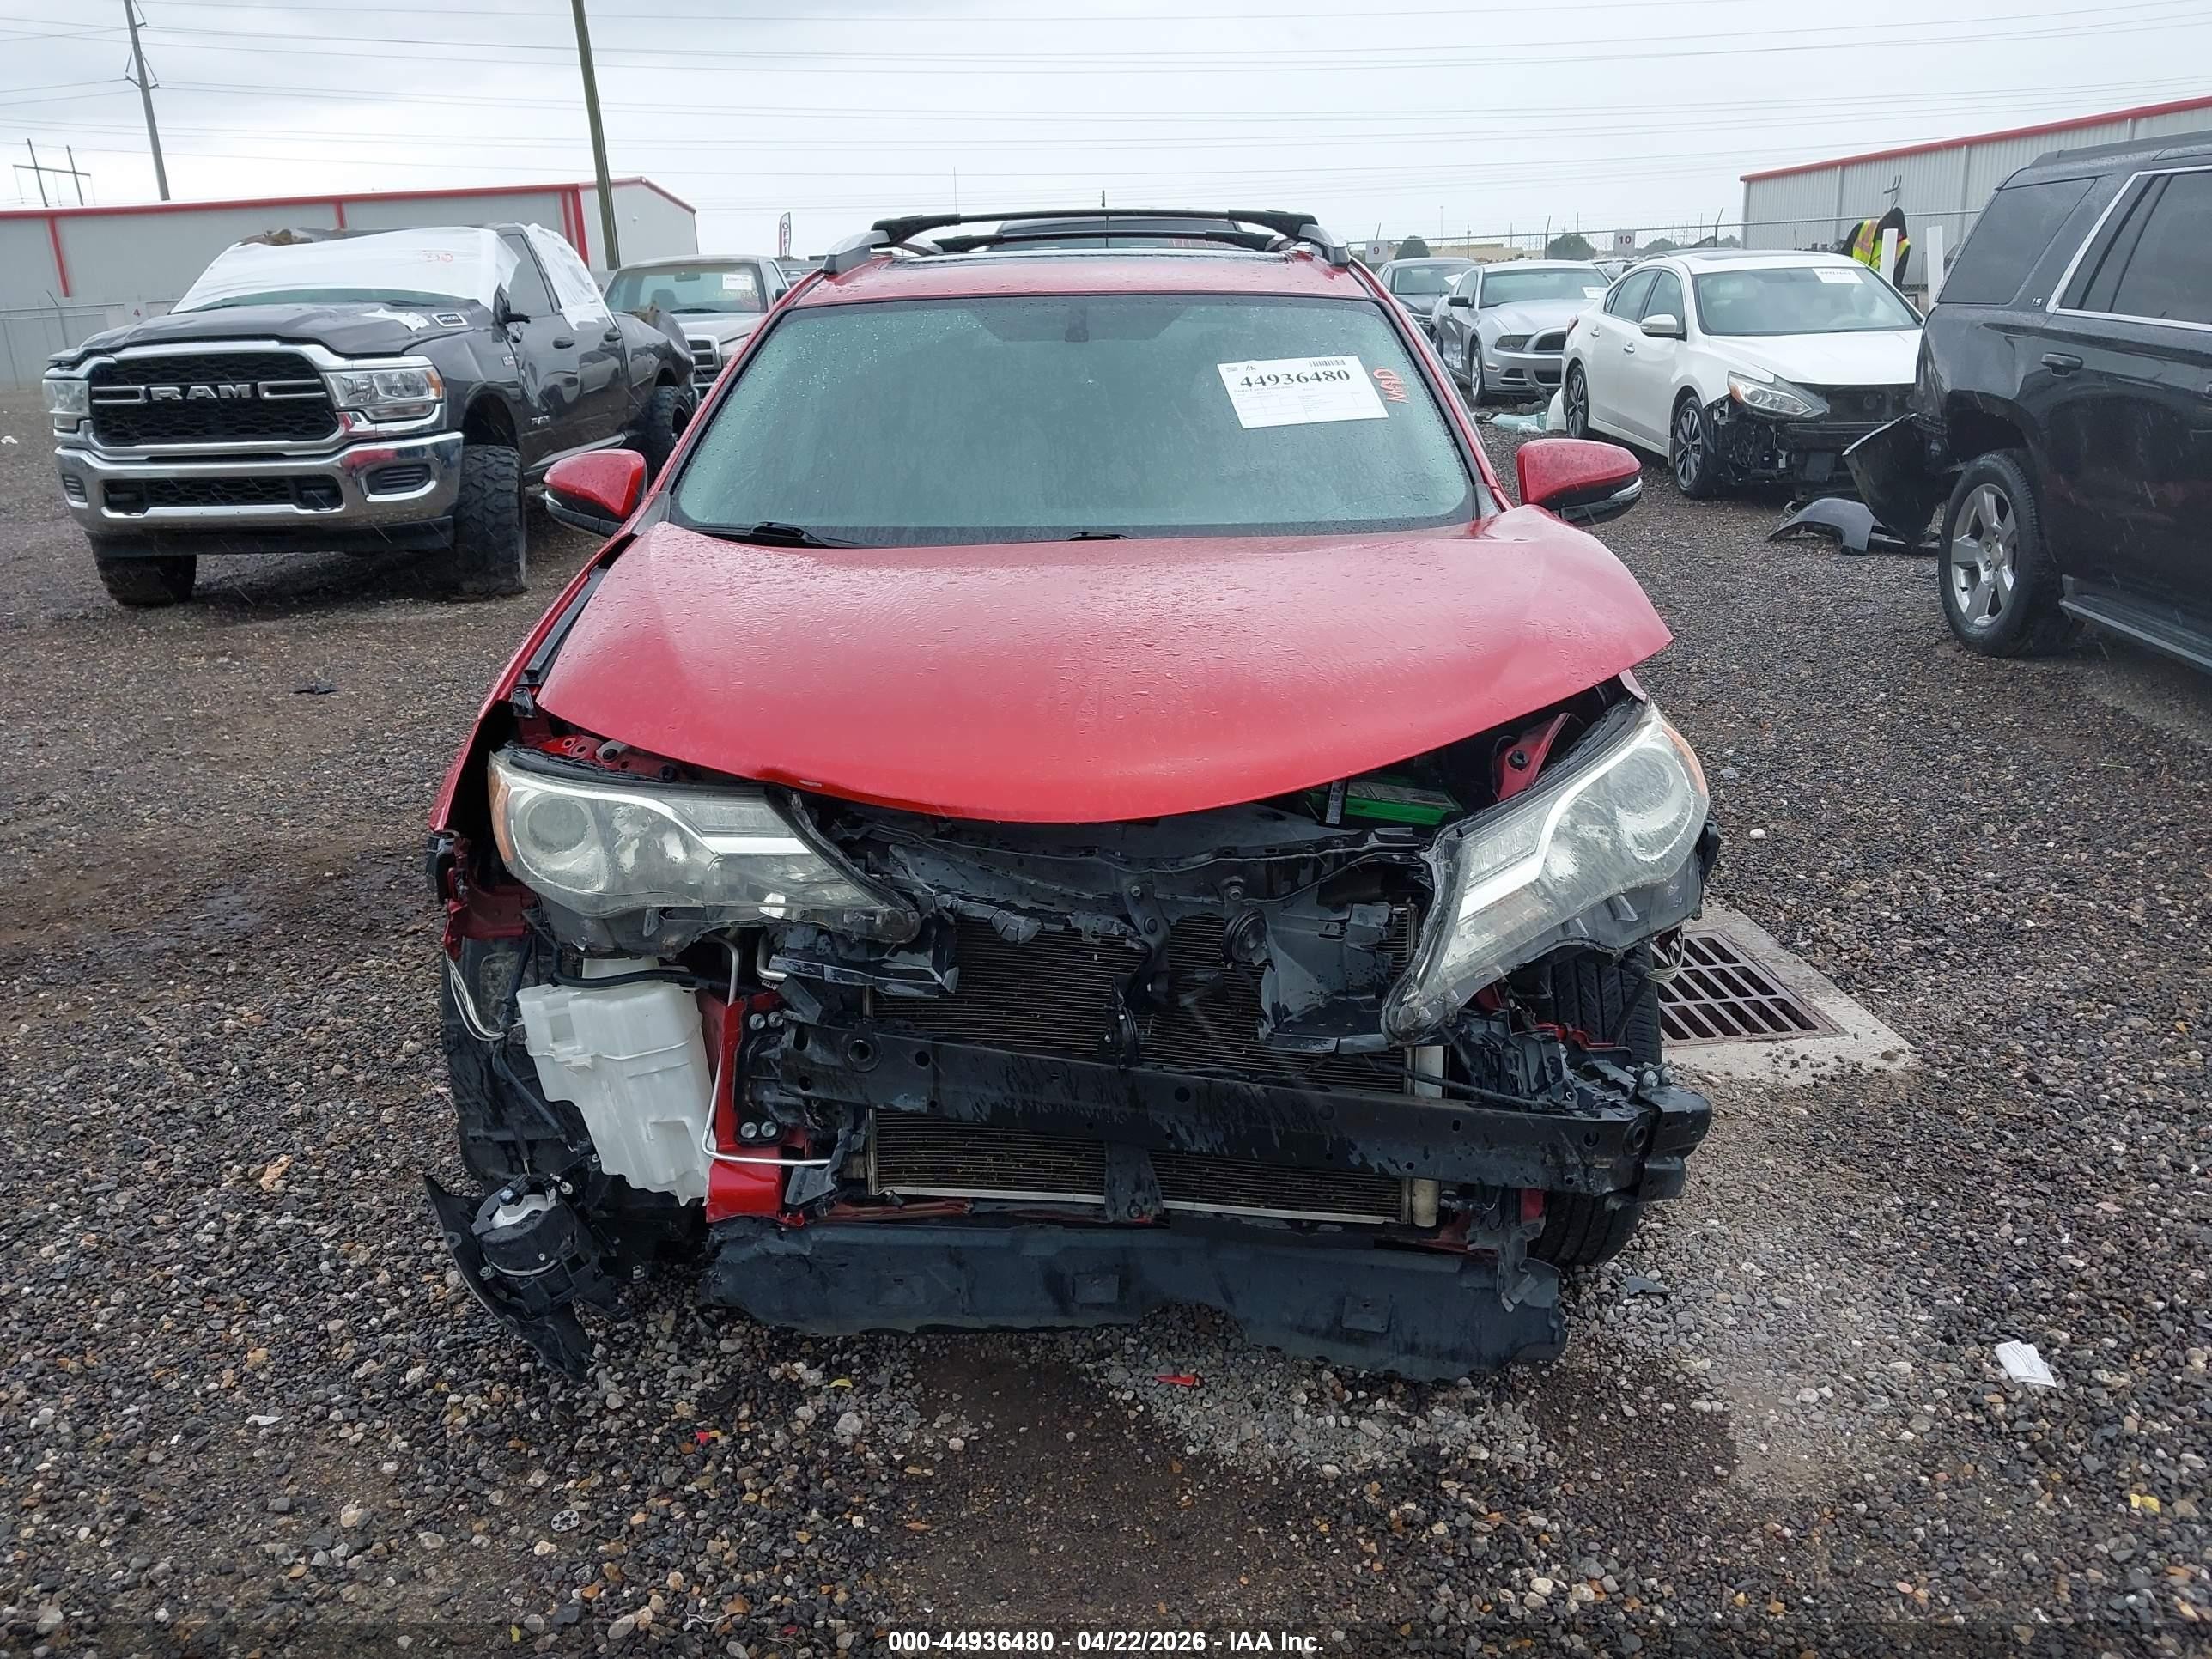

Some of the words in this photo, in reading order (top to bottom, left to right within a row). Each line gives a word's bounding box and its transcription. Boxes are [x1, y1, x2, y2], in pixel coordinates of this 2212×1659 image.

[1619, 235, 1632, 245] 10
[1373, 246, 1380, 255] 9
[133, 308, 141, 317] 4
[1240, 368, 1351, 388] 44936480
[149, 384, 252, 401] RAM
